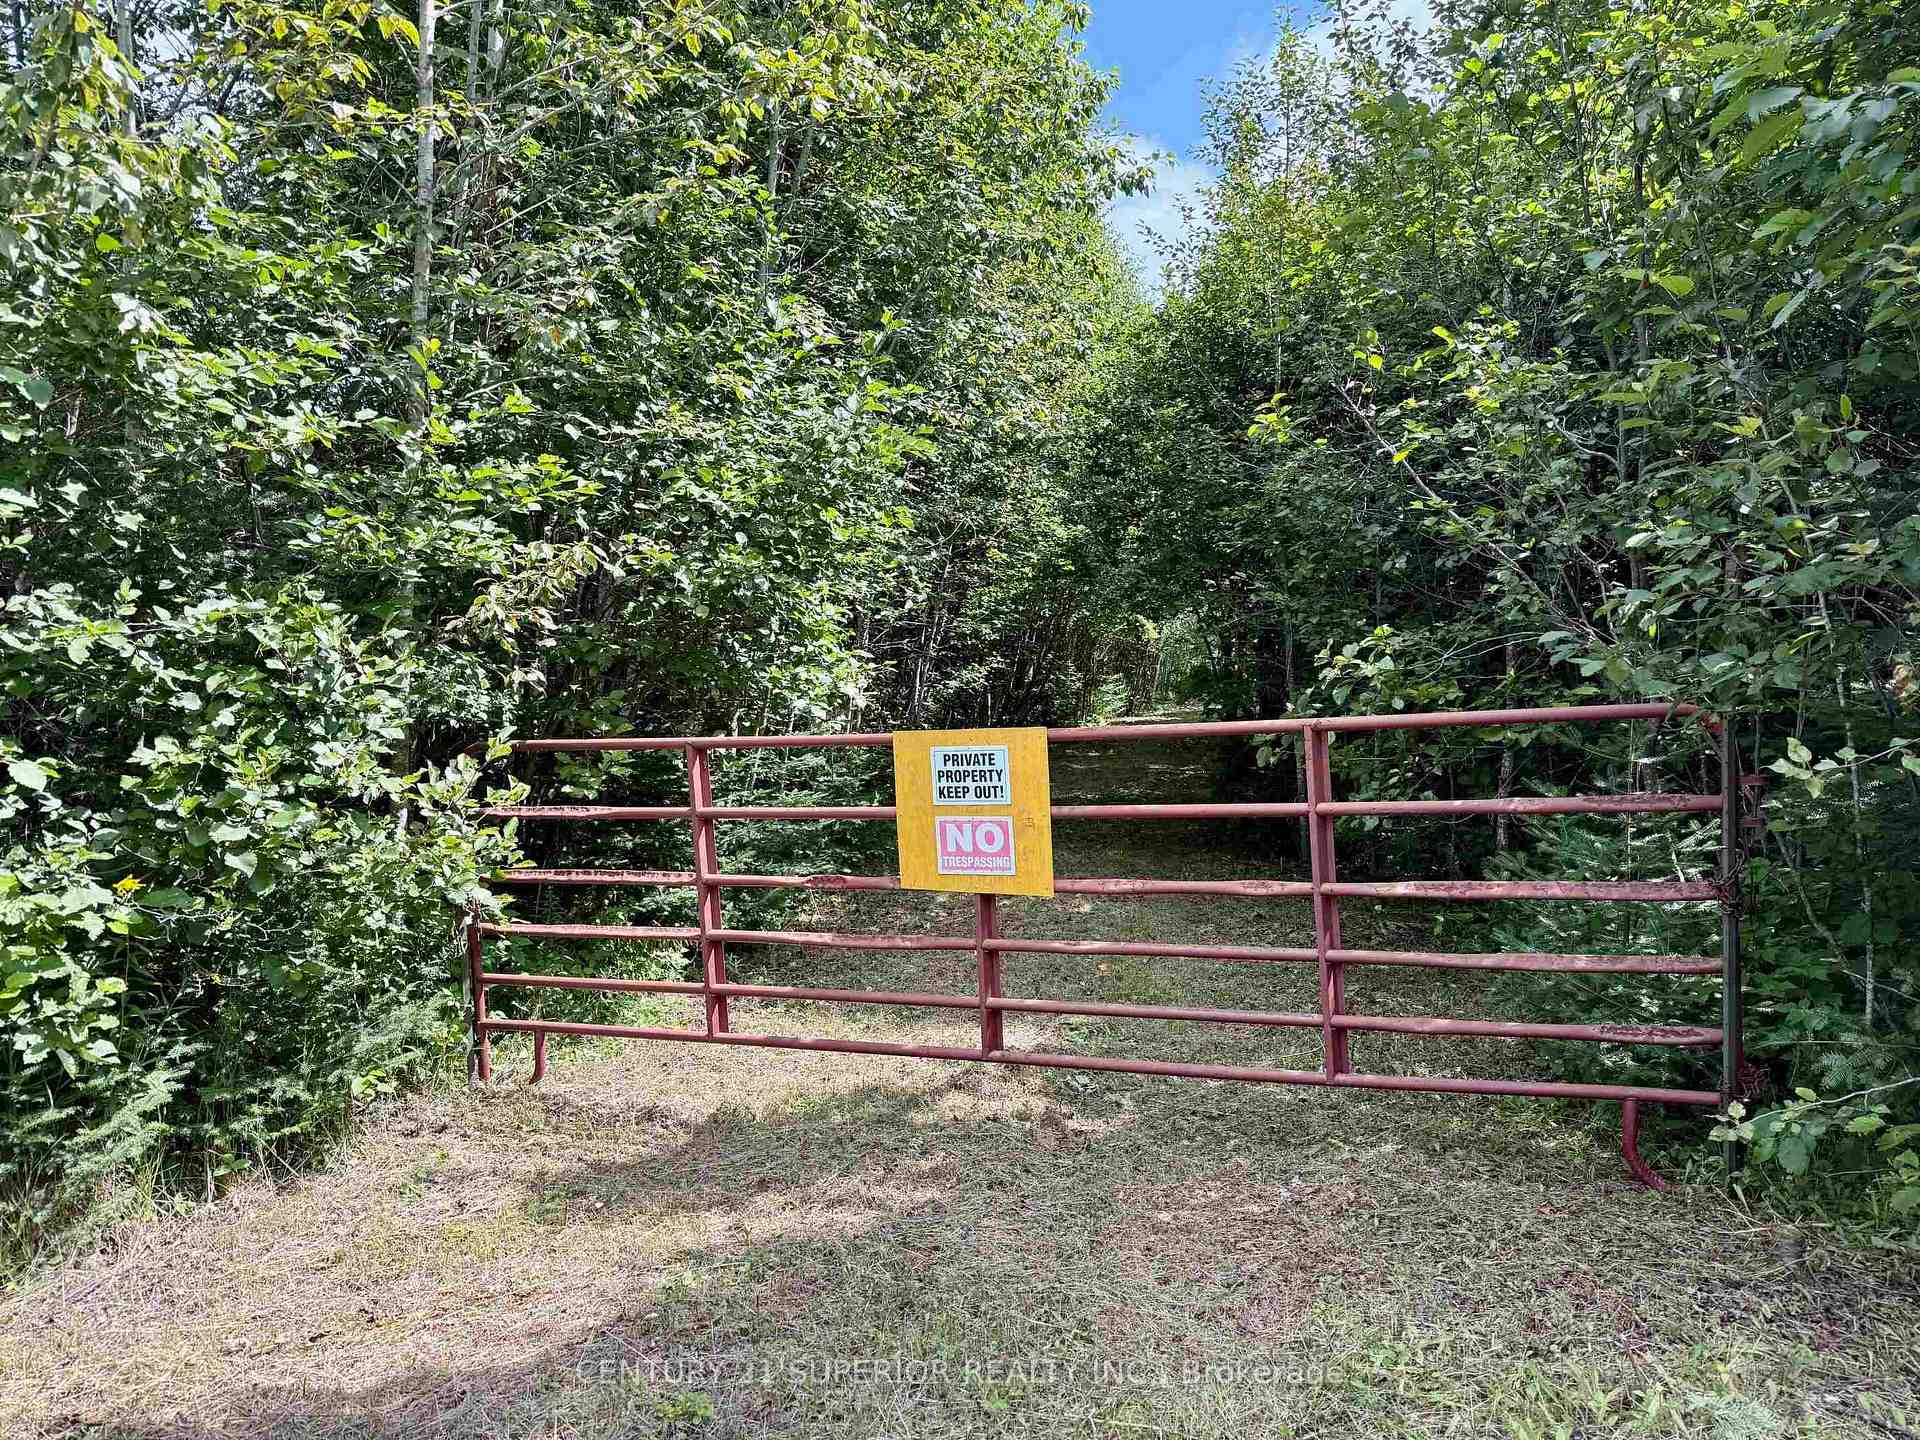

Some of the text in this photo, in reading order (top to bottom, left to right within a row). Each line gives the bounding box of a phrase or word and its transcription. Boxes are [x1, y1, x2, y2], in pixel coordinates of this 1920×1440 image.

[943, 753, 996, 767] PRIVATE
[937, 769, 1003, 783] PROPERTY
[938, 785, 1004, 799] KEEP OUT!
[946, 821, 1005, 853] NO
[943, 856, 1009, 868] TRESPASSING
